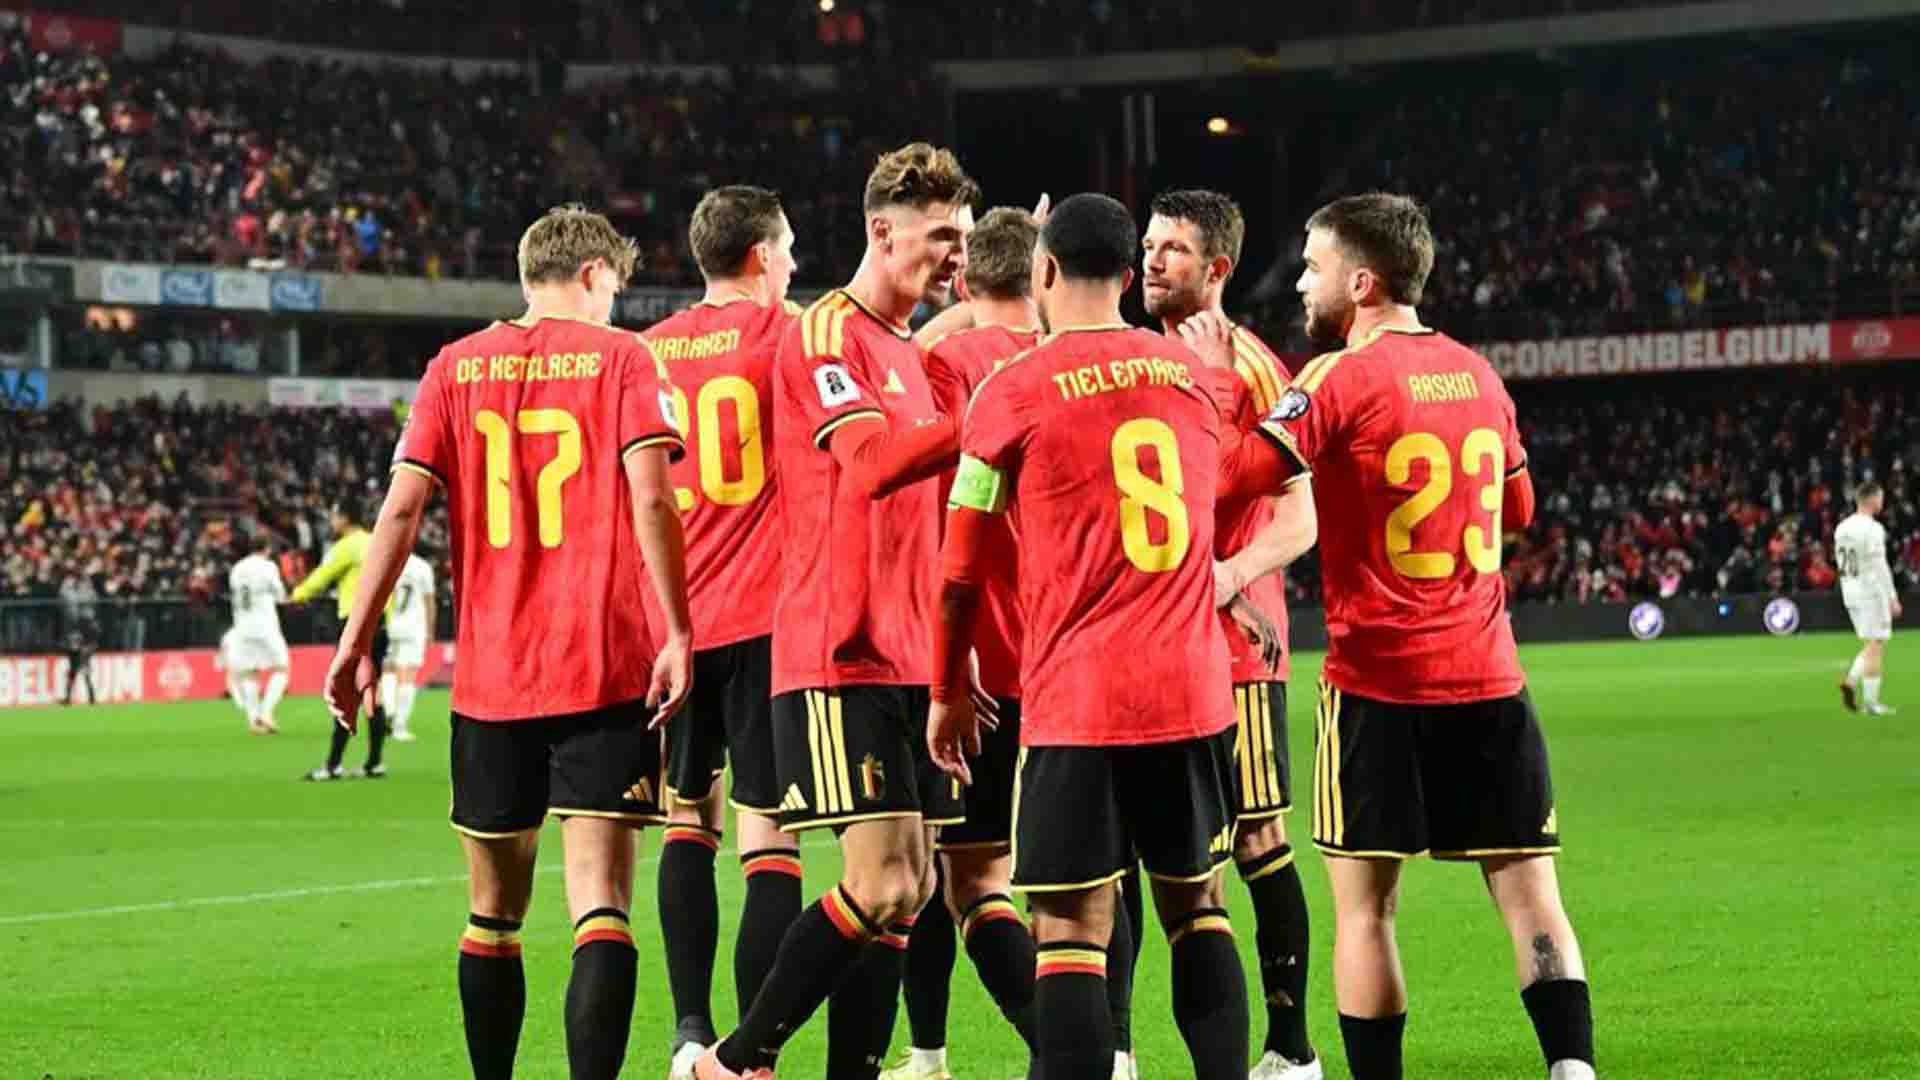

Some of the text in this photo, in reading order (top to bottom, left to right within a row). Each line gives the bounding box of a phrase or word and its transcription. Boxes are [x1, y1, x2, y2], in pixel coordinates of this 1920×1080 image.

[456, 357, 483, 385] DE
[1052, 357, 1193, 401] TIELEMANS
[1408, 366, 1480, 405] RASKIN
[474, 408, 582, 549] 17
[1111, 417, 1190, 574] 8
[1385, 427, 1505, 579] 23
